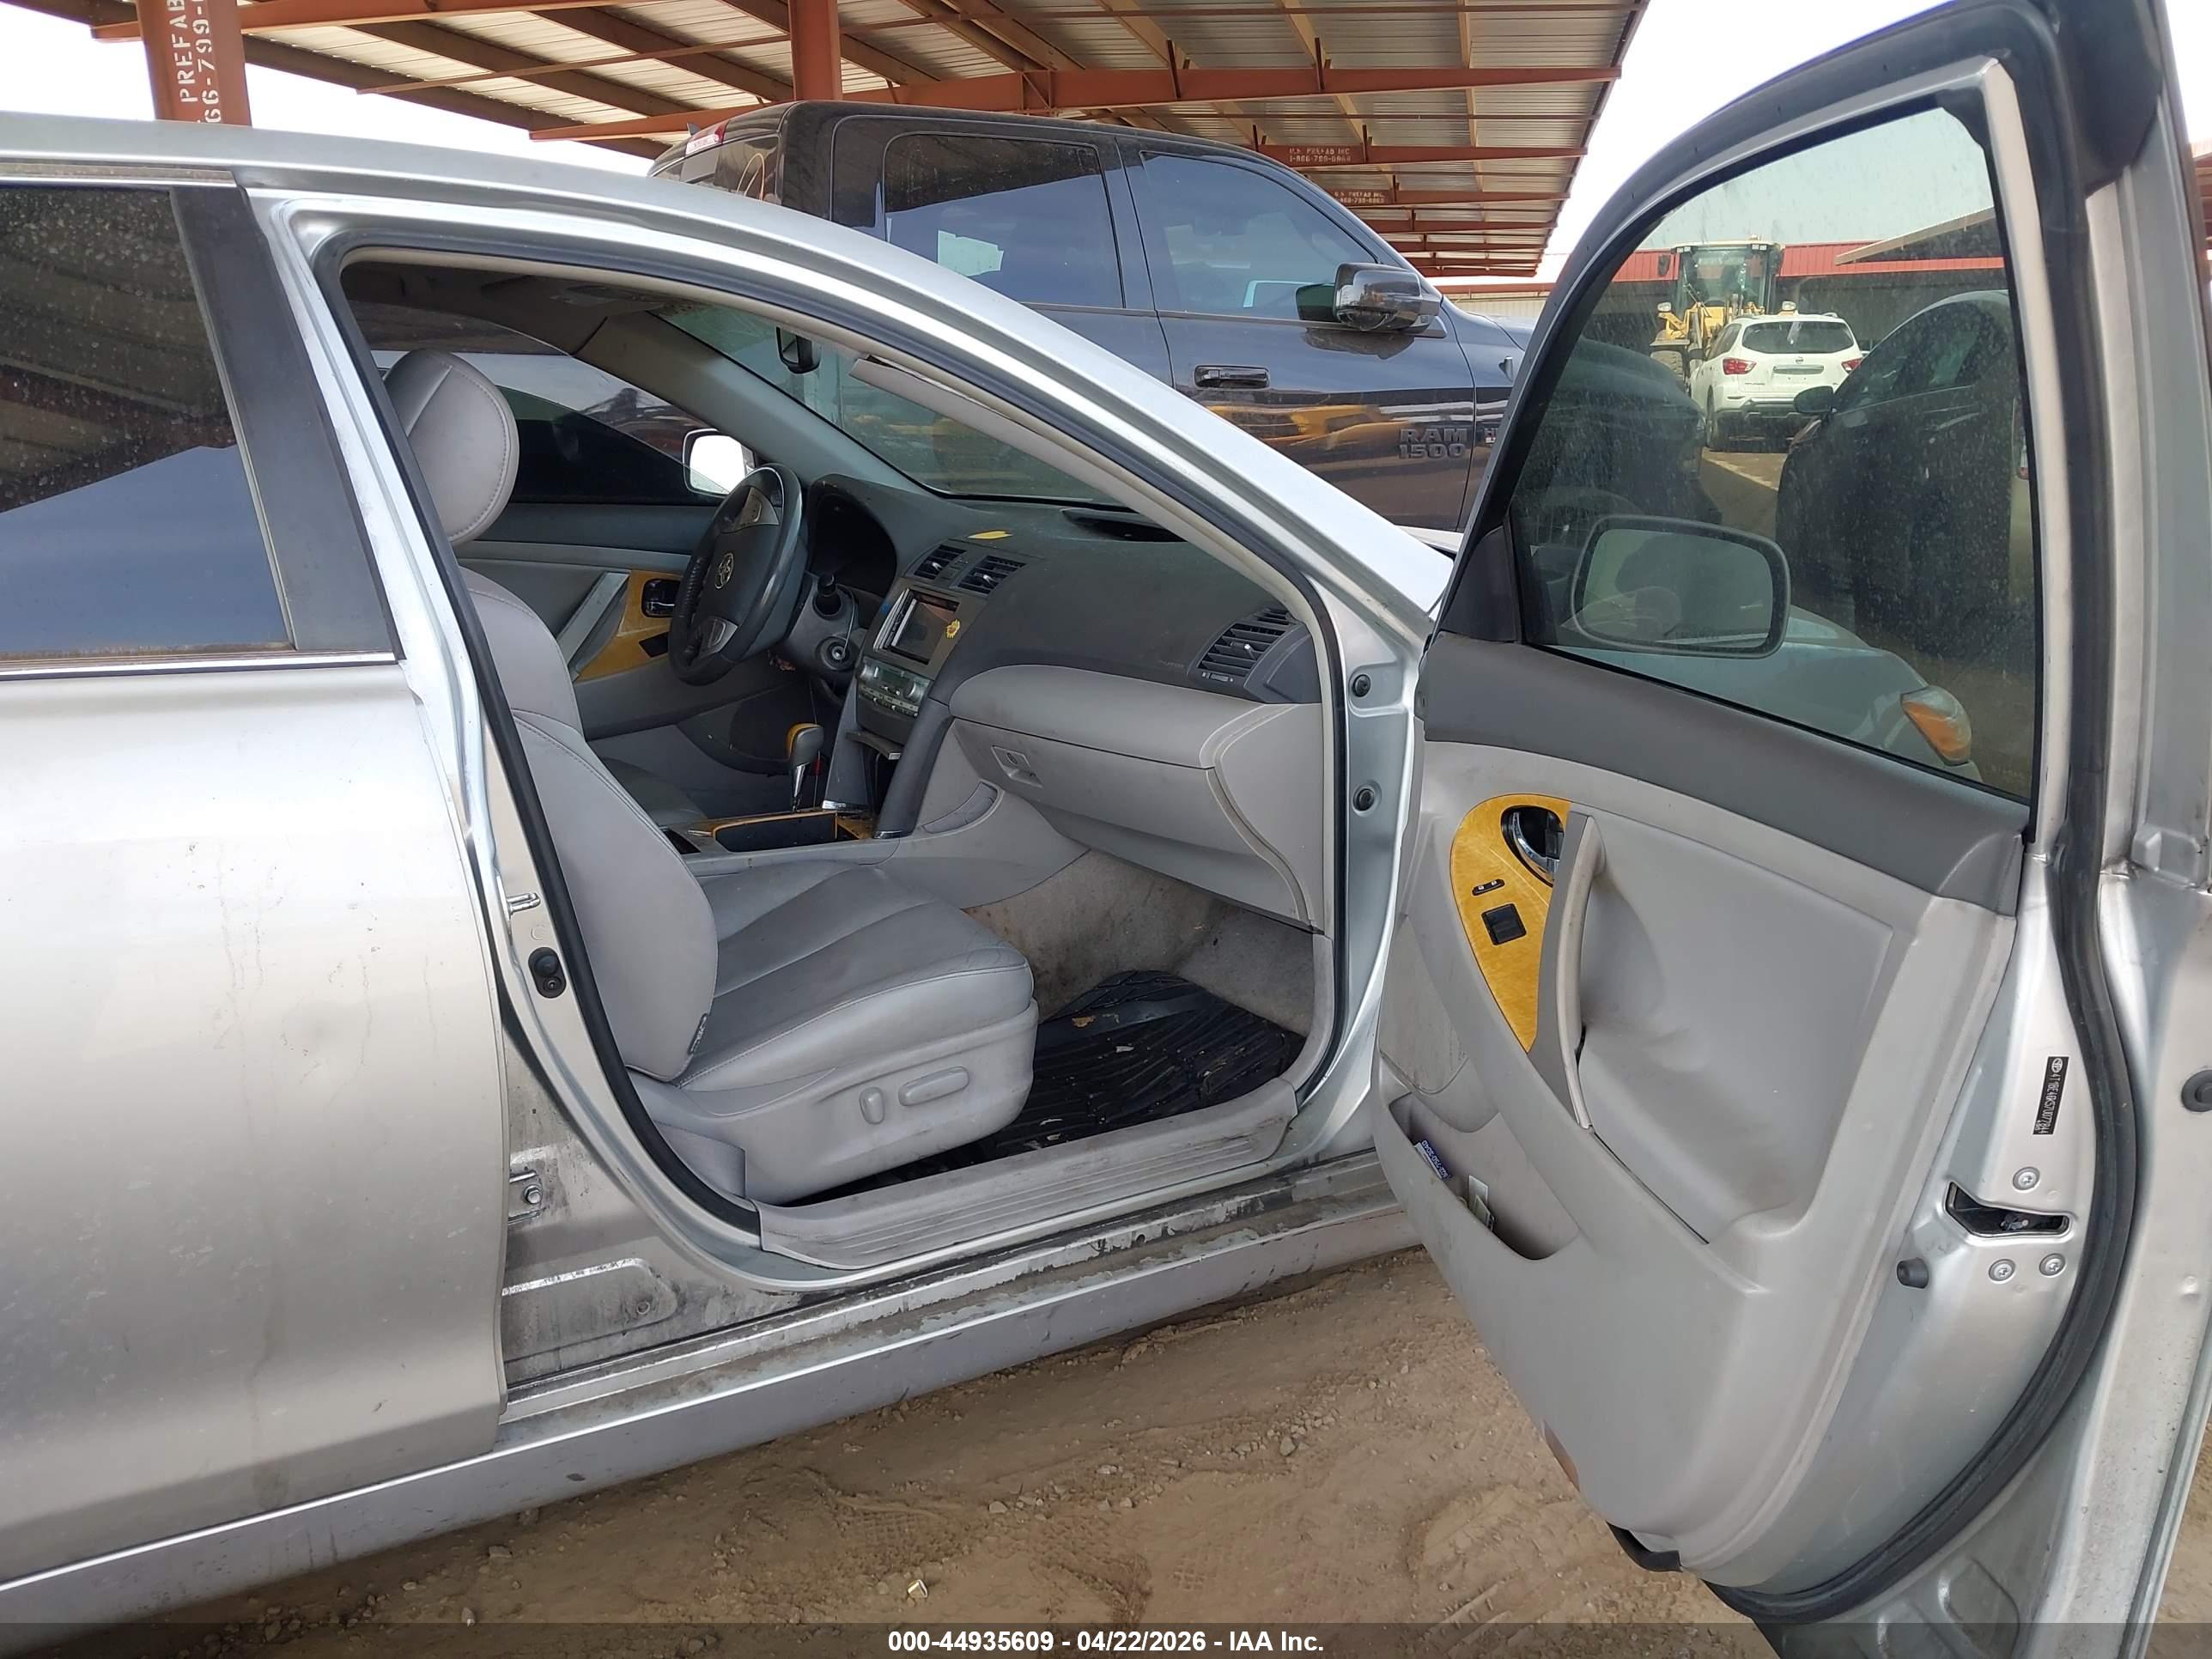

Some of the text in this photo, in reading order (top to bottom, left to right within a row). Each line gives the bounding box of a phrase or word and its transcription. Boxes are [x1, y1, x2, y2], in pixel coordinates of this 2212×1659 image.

[167, 0, 199, 102] PREFAB
[191, 0, 222, 123] 66-799-
[1399, 443, 1466, 459] 1500
[1400, 428, 1468, 444] RAM
